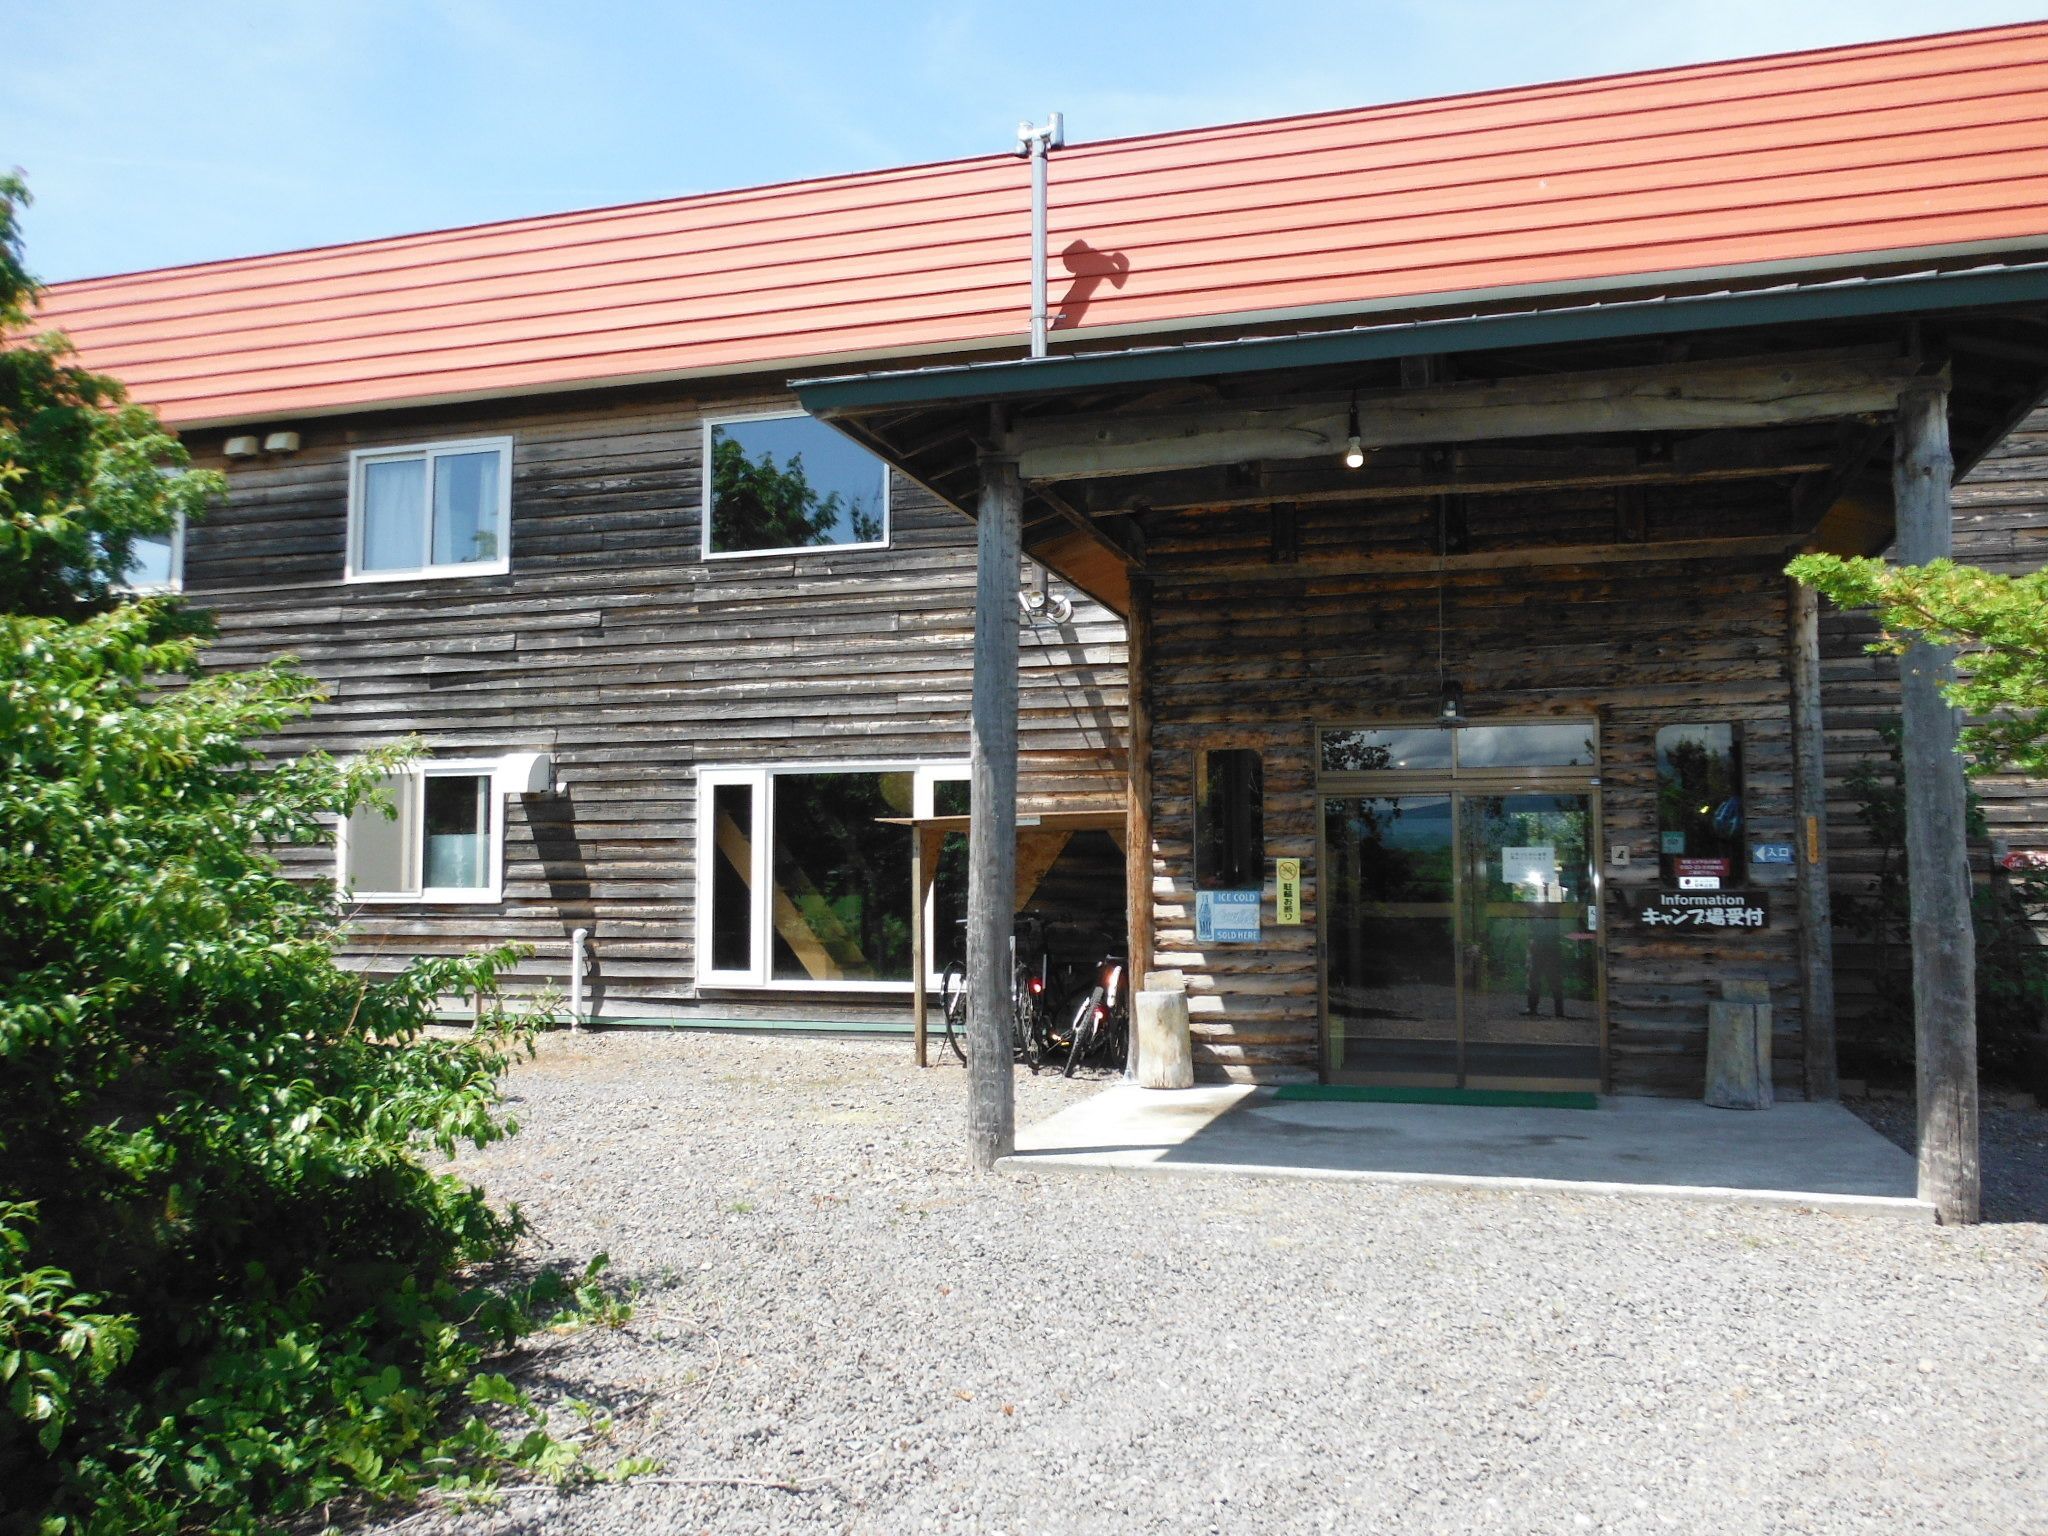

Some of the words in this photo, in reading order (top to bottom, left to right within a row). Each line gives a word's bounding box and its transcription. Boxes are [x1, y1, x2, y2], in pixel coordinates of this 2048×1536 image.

[1767, 847, 1789, 857] 入口
[1218, 893, 1231, 902] ICE
[1233, 893, 1255, 902] COLD
[1660, 894, 1745, 906] Information
[1641, 907, 1765, 926] キャンプ場受付
[1217, 931, 1237, 940] SOLD
[1240, 931, 1257, 940] HERE
